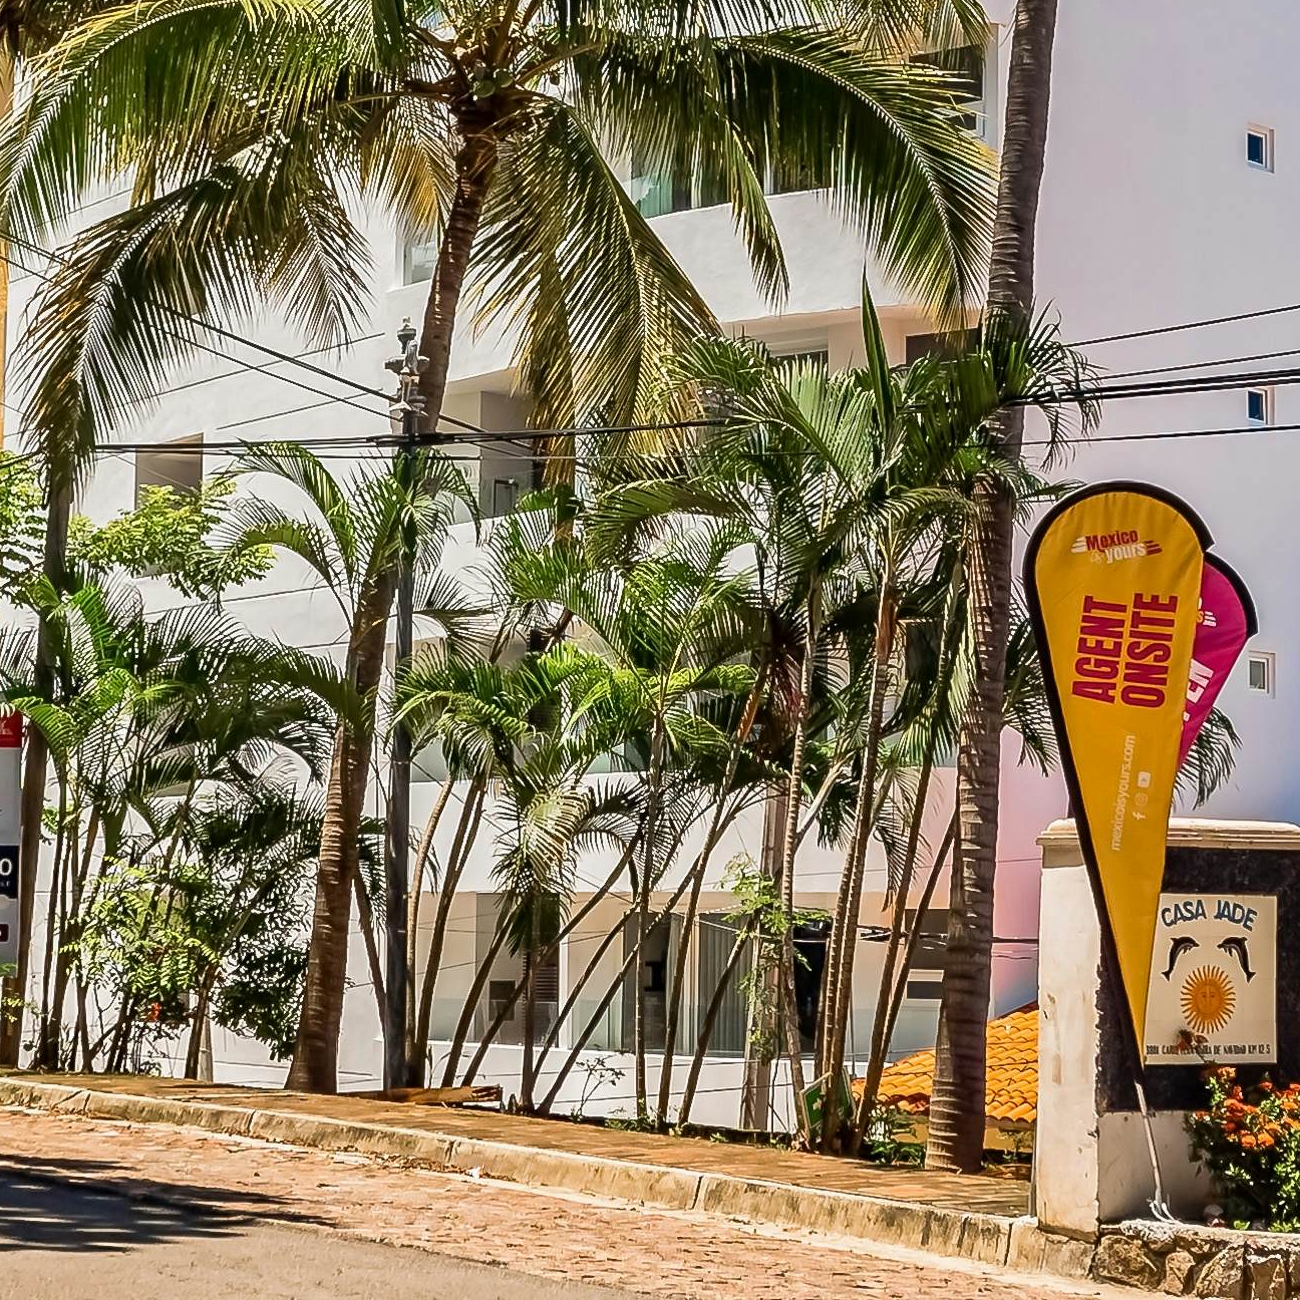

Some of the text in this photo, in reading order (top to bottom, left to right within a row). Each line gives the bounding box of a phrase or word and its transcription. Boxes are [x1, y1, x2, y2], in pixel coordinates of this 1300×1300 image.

[1085, 529, 1139, 553] Mexico
[1105, 542, 1147, 565] yours
[1072, 595, 1128, 704] AGENT
[1121, 592, 1179, 708] ONSITE
[1161, 899, 1258, 932] CASA JADE
